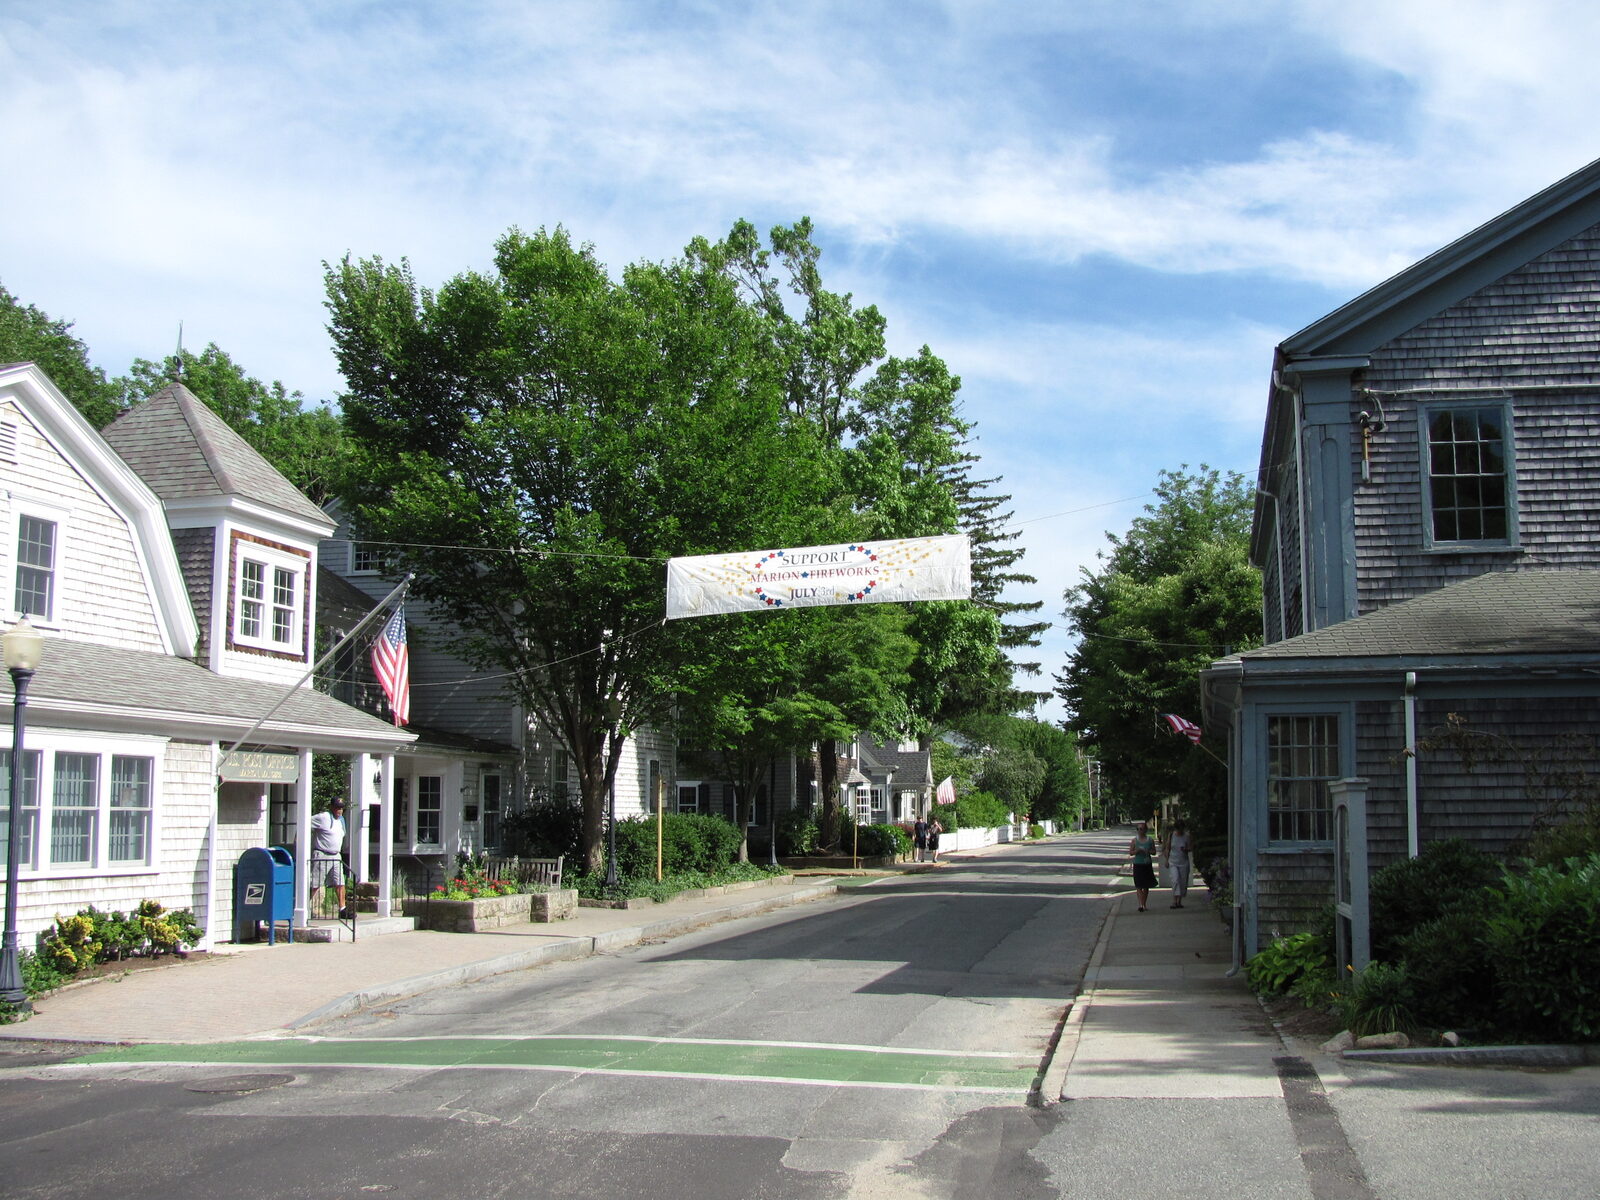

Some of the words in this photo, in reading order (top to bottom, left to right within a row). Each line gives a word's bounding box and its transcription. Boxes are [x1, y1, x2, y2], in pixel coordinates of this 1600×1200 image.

[782, 551, 848, 565] SUPPORT
[751, 571, 799, 583] MARION
[810, 566, 880, 579] FIREWORKS
[790, 588, 818, 601] JULY
[820, 586, 835, 596] 3rd
